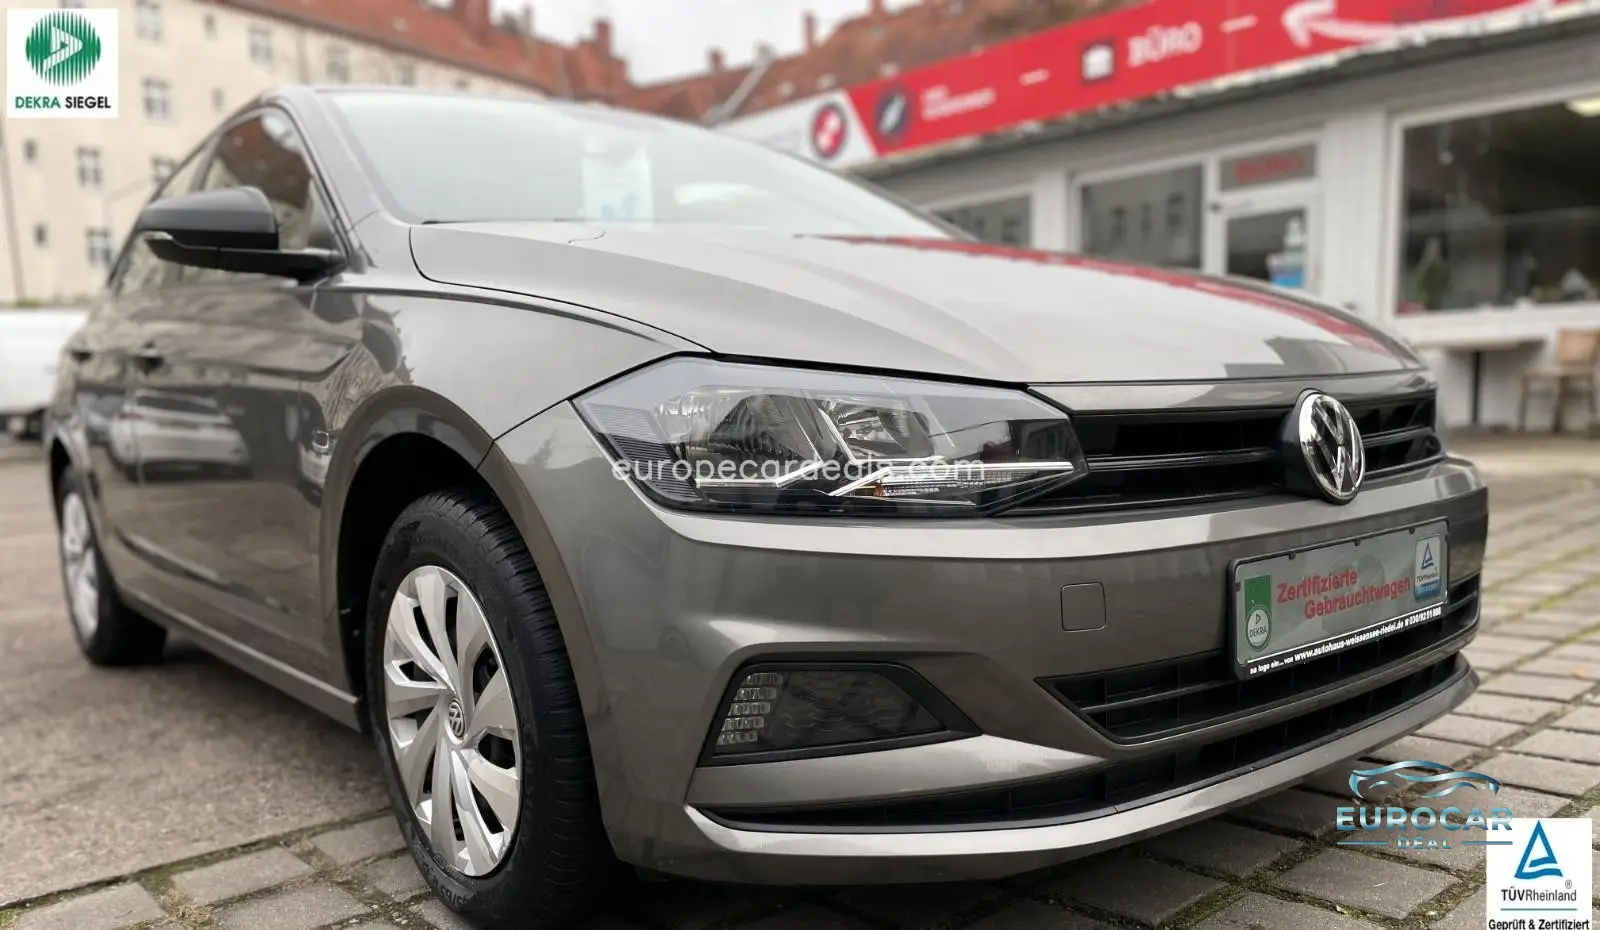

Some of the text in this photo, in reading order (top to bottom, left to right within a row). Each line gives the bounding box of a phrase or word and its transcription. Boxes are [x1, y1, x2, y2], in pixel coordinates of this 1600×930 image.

[1277, 567, 1358, 603] Zertifizierte
[1305, 576, 1411, 619] Gebrauchtwagen
[1249, 626, 1267, 638] DEKRA
